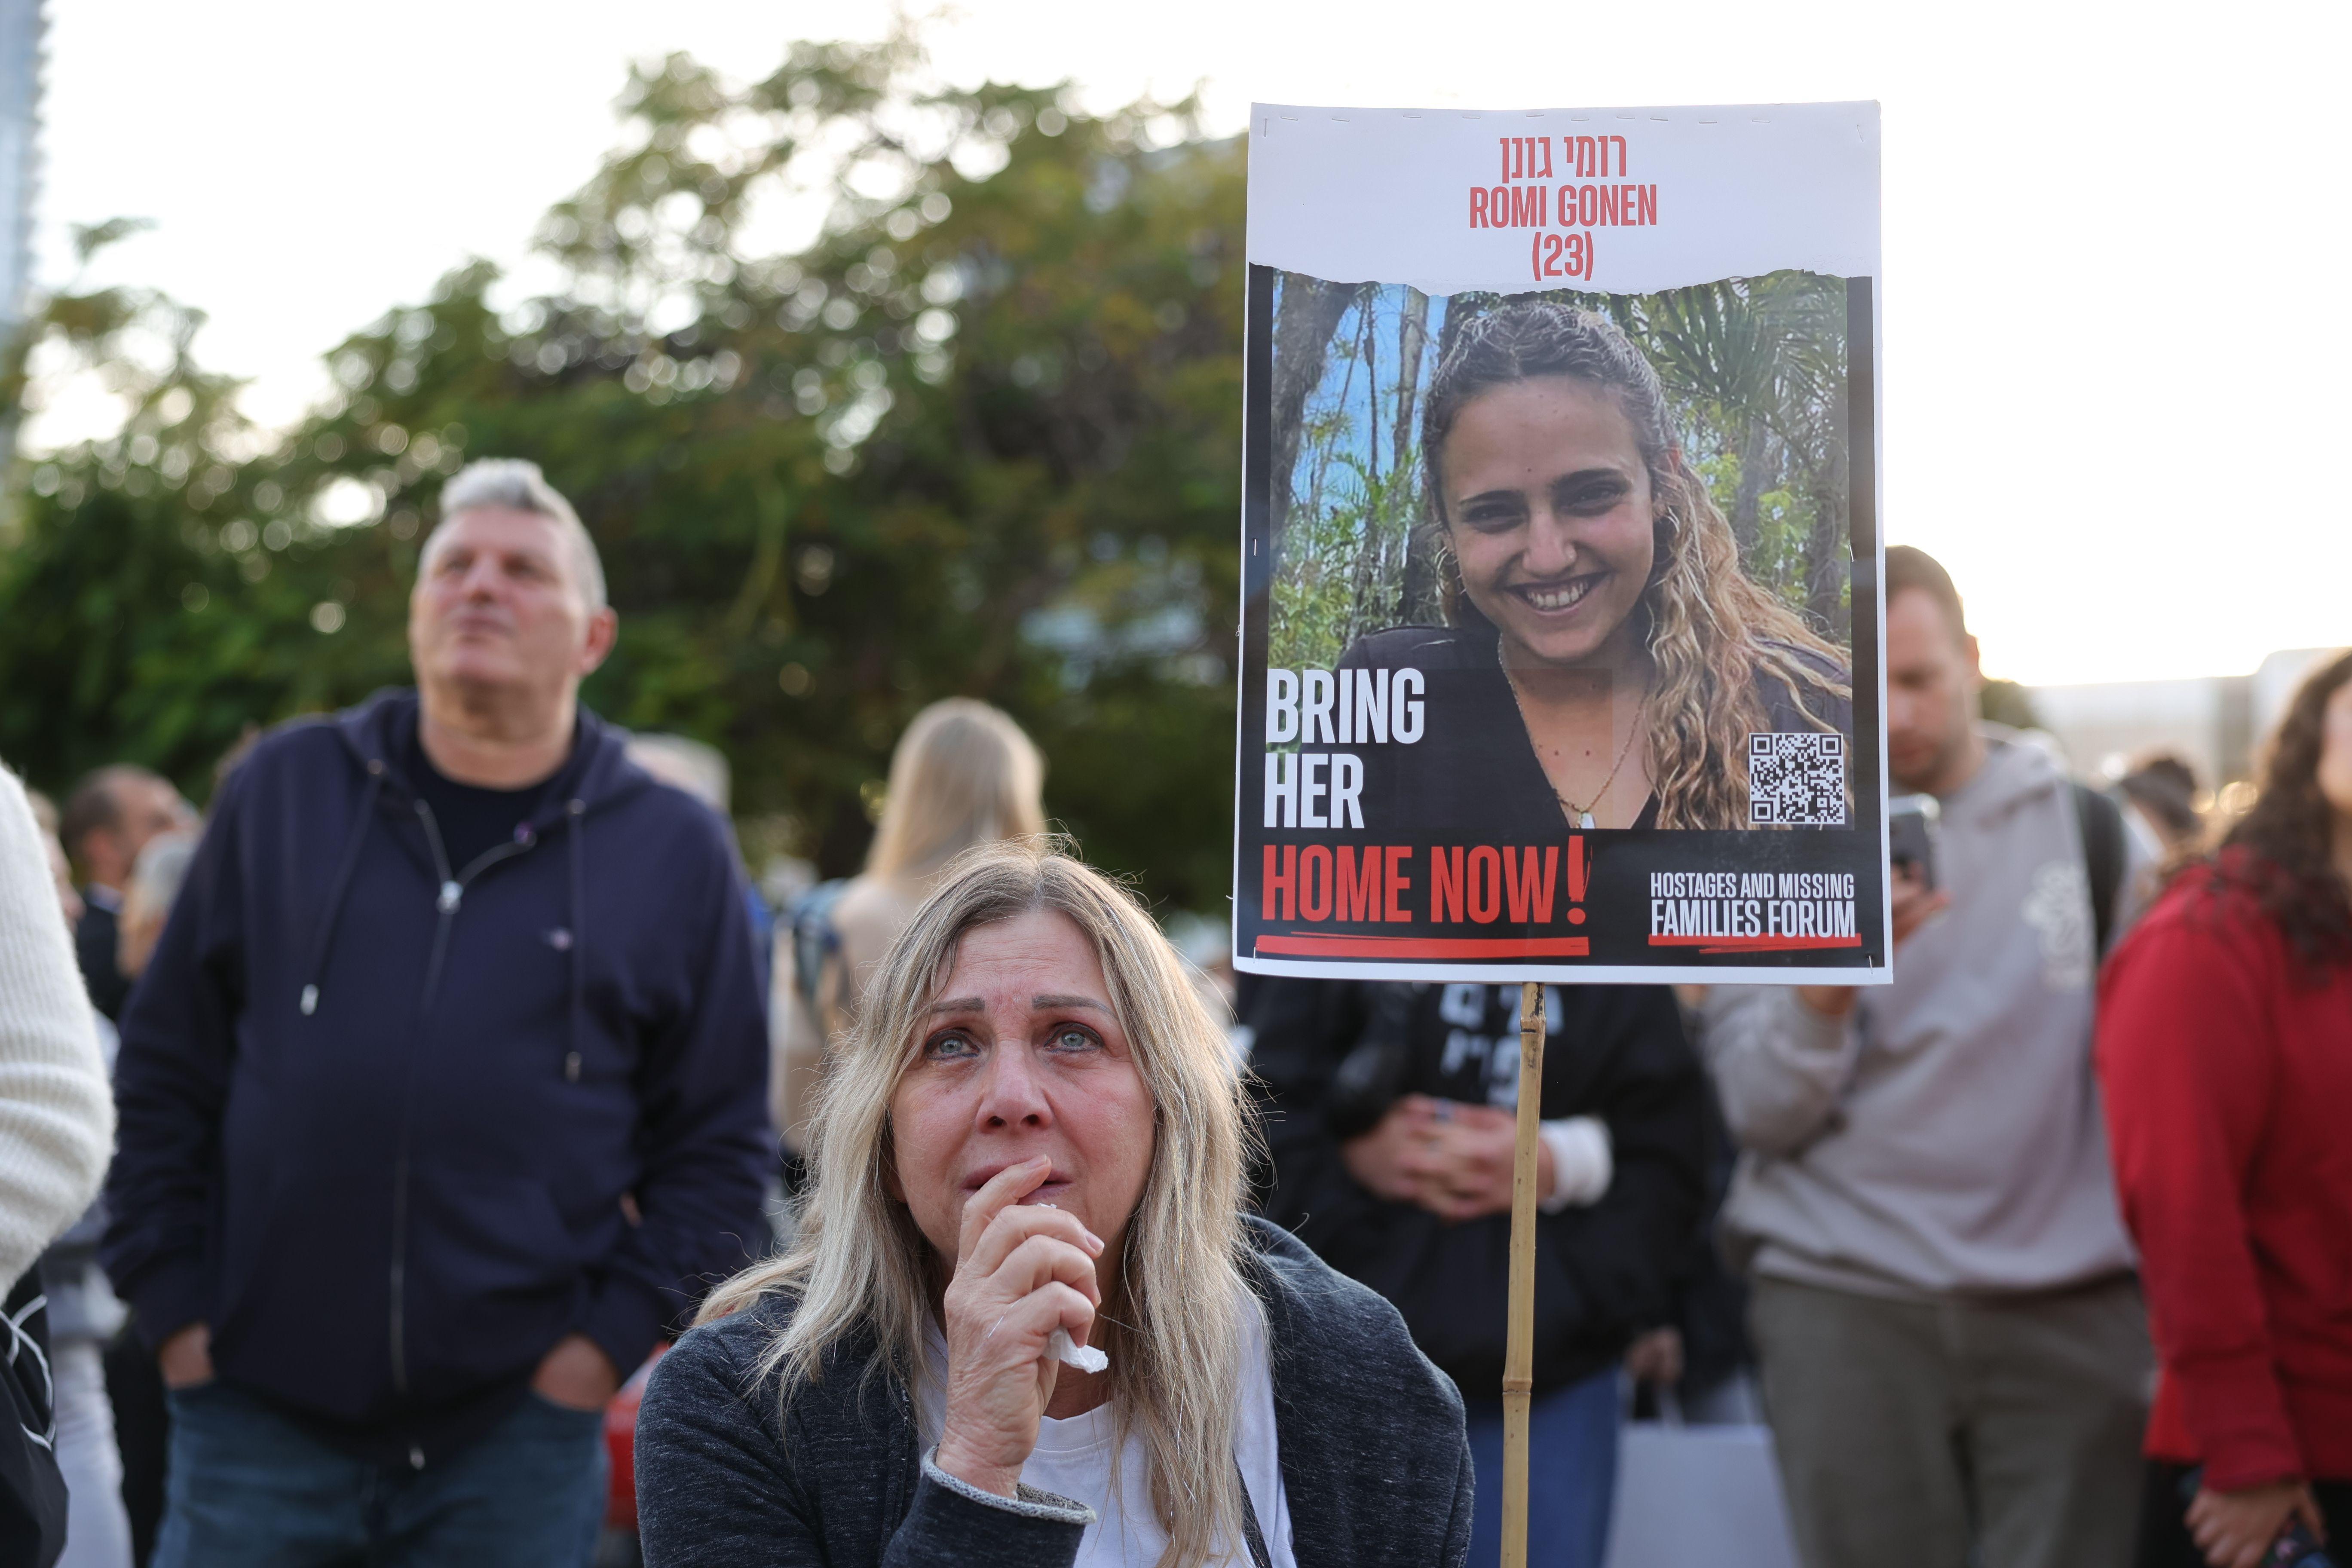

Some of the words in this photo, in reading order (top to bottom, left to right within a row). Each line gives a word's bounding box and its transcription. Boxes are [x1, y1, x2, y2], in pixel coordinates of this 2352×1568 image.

[1500, 137, 1553, 184] גונן
[1564, 136, 1626, 177] רומי
[1470, 186, 1547, 228] ROMI
[1558, 185, 1657, 227] GONEN
[1532, 231, 1594, 281] (23)
[1265, 668, 1425, 744] BRING
[1264, 753, 1365, 829] HER
[1262, 844, 1414, 923] HOME
[1430, 835, 1592, 926] NOW!
[1651, 872, 1737, 898] HOSTAGES
[1740, 873, 1775, 898] AND
[1778, 873, 1855, 899] MISSING
[1651, 899, 1761, 938] FAMILIES
[1767, 900, 1856, 938] FORUM
